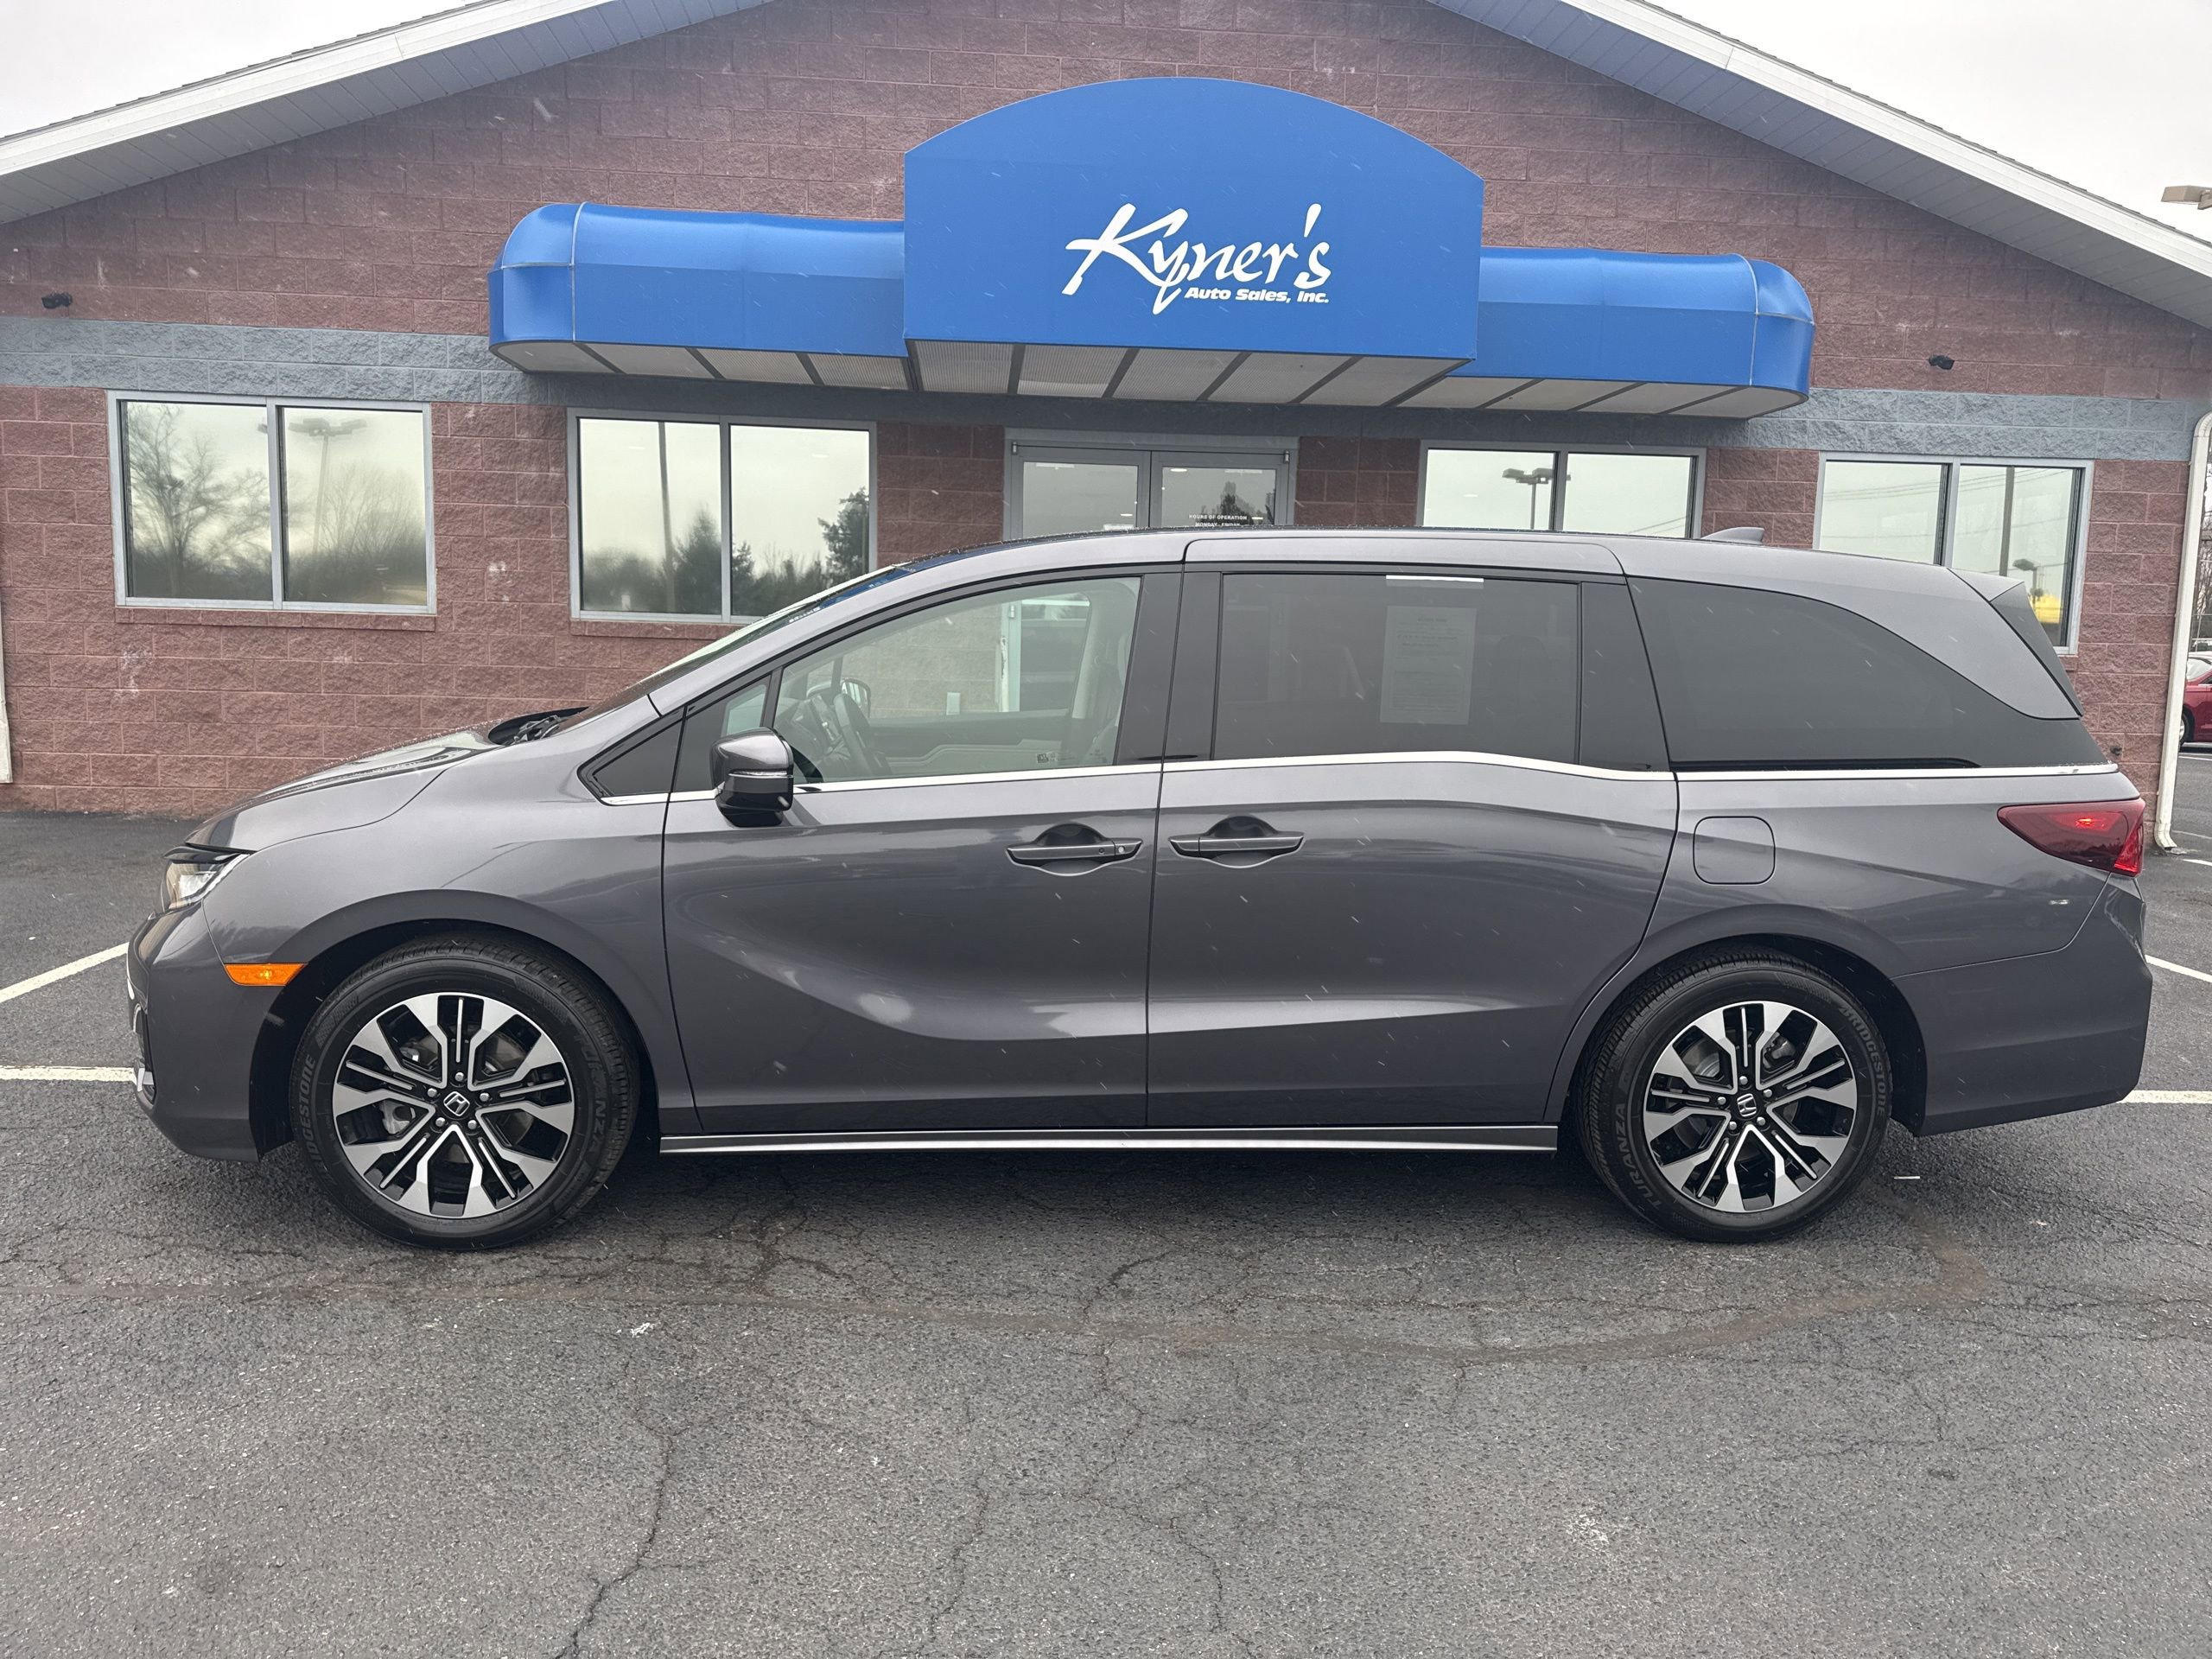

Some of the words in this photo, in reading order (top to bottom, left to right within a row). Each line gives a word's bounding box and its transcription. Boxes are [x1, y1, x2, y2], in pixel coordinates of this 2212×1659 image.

[1061, 203, 1332, 315] Kyner's
[1185, 287, 1231, 300] Auto
[1235, 289, 1291, 303] Sales,
[1296, 290, 1329, 302] Inc.
